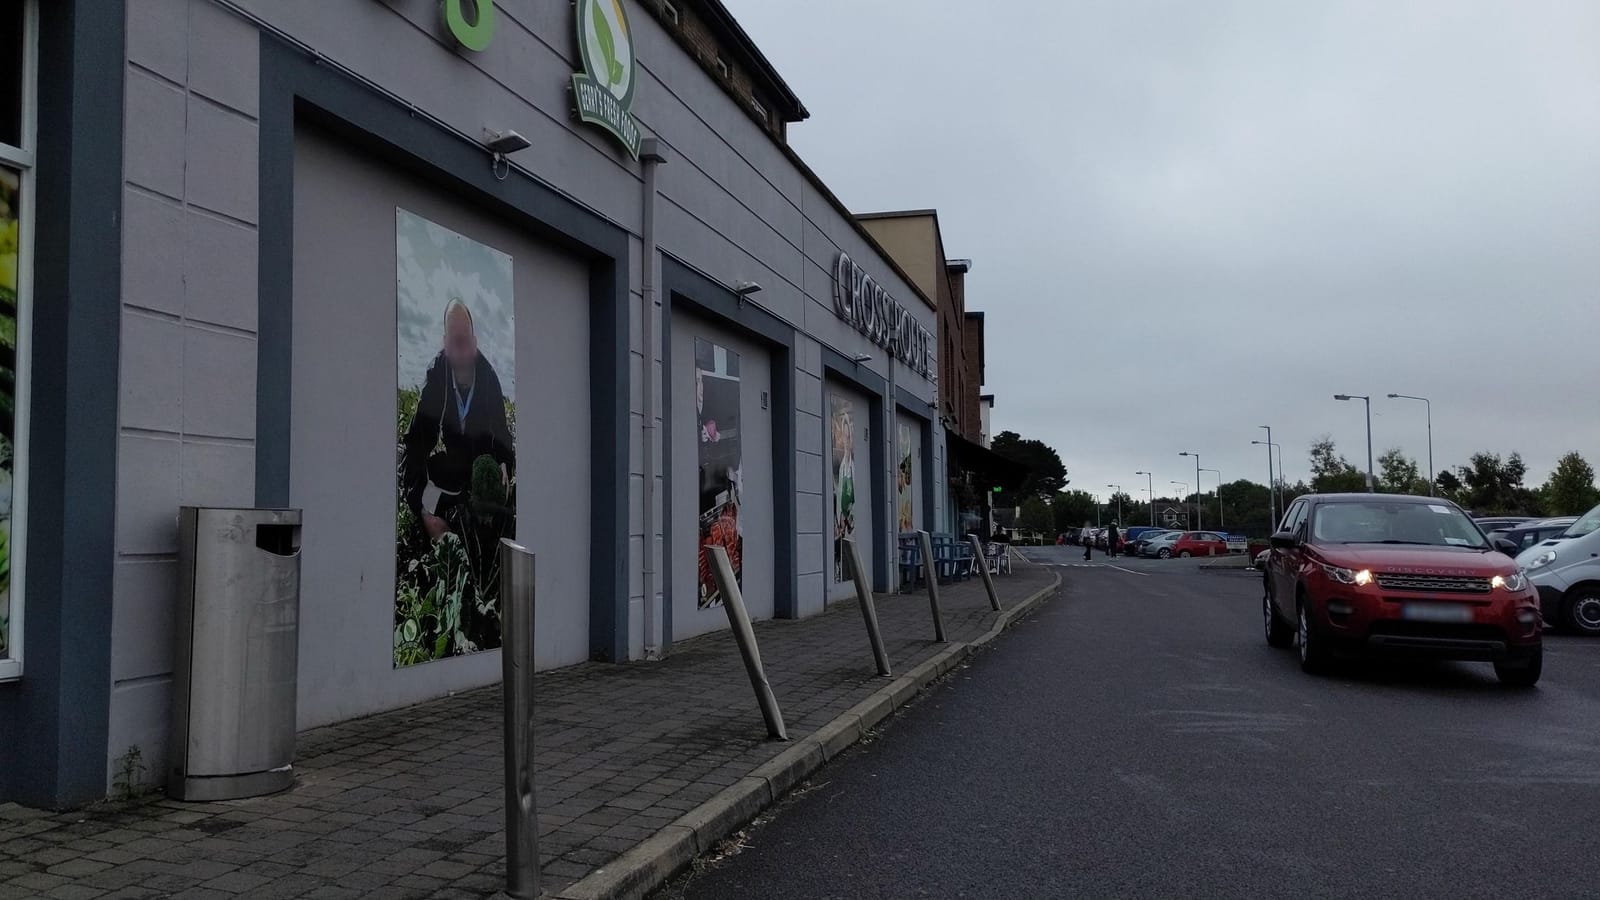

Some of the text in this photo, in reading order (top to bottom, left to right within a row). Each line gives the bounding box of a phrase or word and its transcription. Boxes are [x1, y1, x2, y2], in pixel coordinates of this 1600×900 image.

[603, 93, 620, 129] FRESH
[620, 110, 637, 150] FOODS
[1387, 566, 1477, 575] DISCOVERY
